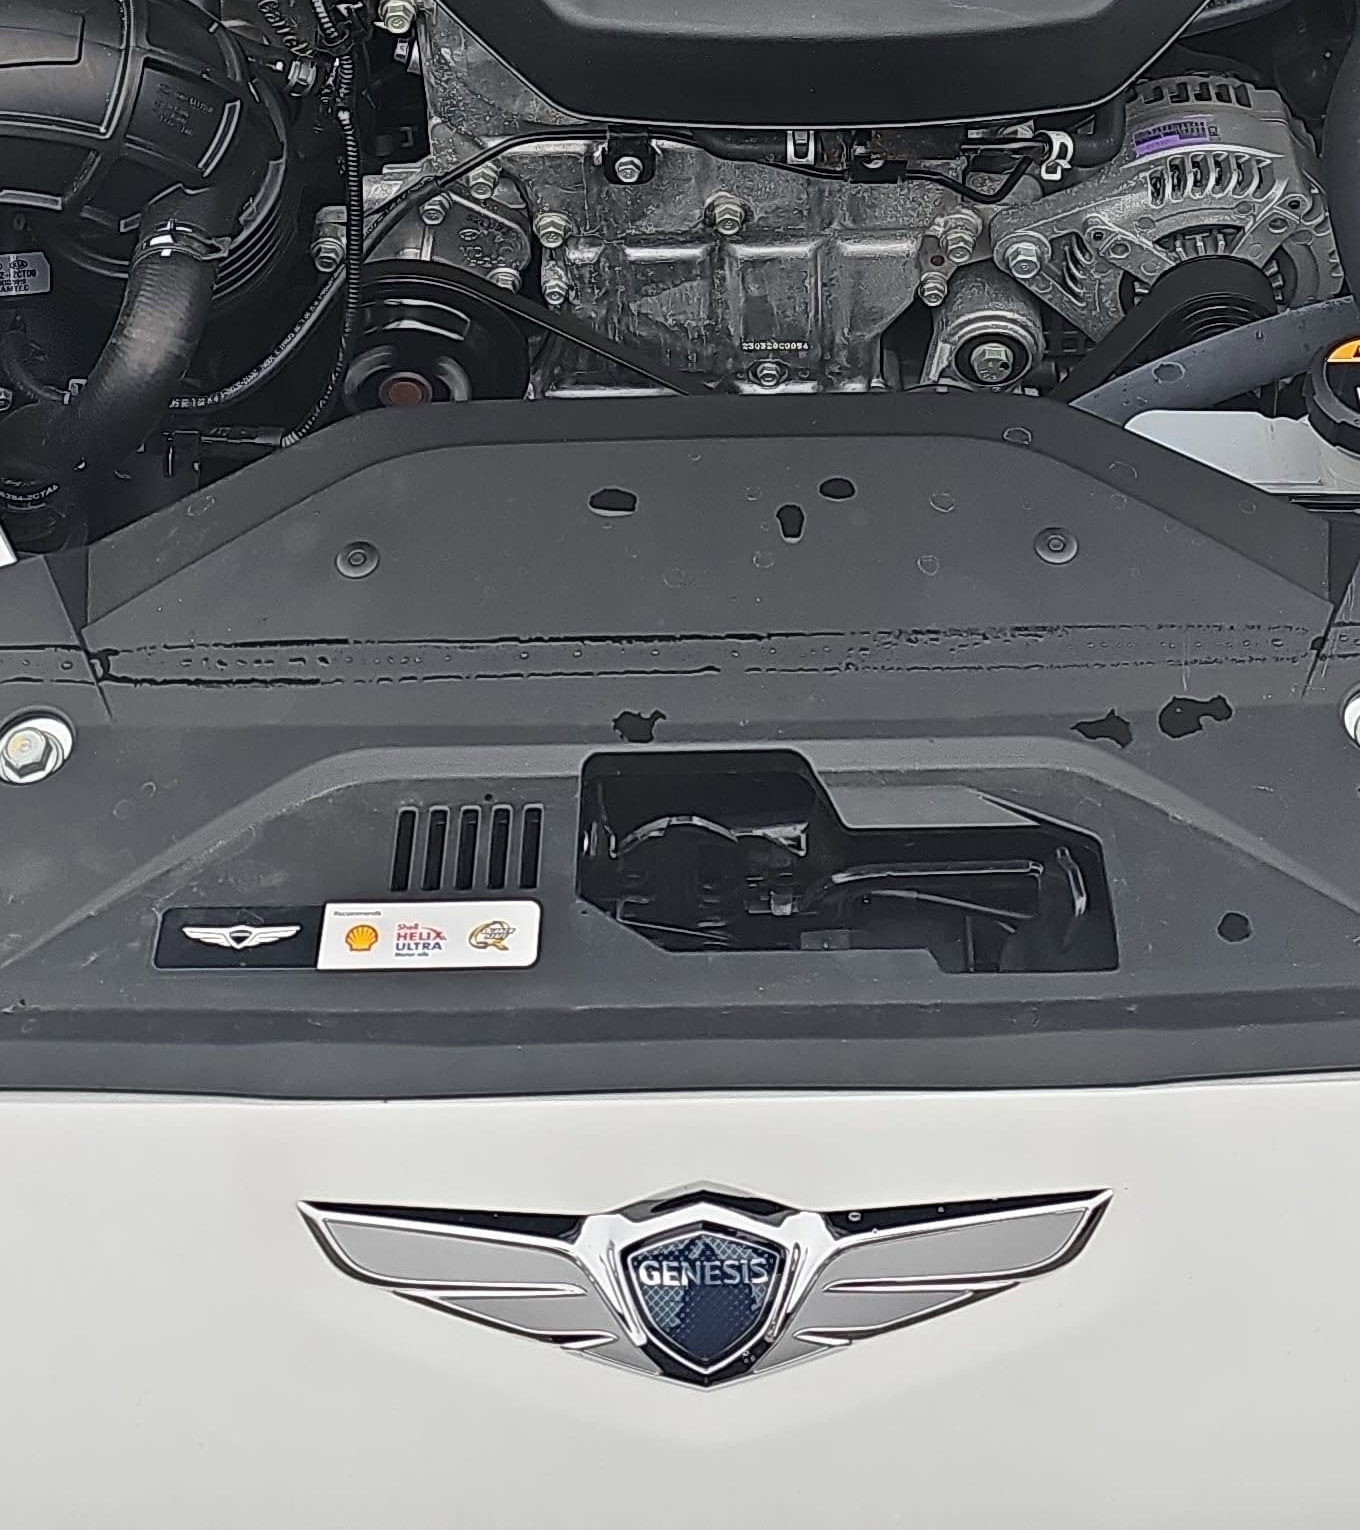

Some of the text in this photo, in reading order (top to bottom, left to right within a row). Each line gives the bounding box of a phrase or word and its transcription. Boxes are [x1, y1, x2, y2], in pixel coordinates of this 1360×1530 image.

[397, 923, 420, 931] Shell
[396, 930, 447, 941] HELIX
[395, 941, 443, 951] ULTRA
[638, 1258, 769, 1286] GENESIS
